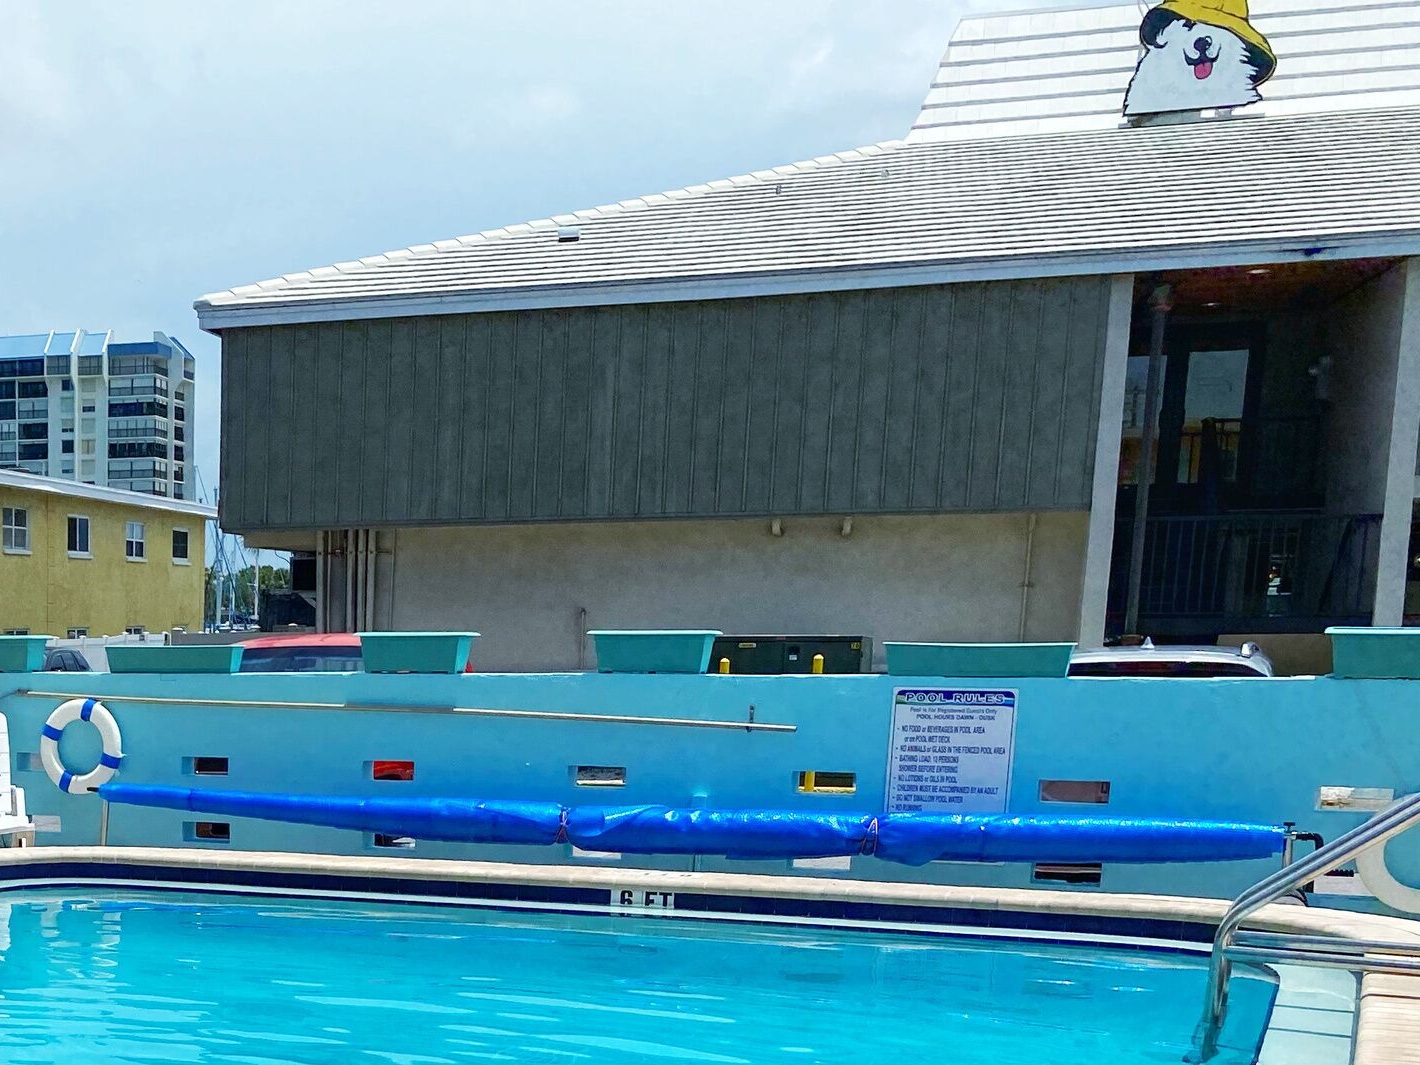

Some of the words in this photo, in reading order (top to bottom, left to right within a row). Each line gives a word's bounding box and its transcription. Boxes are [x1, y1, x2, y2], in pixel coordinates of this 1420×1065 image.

[905, 693, 946, 702] POOL
[953, 694, 1005, 704] RULES
[620, 890, 633, 905] 6
[645, 892, 672, 907] FT
